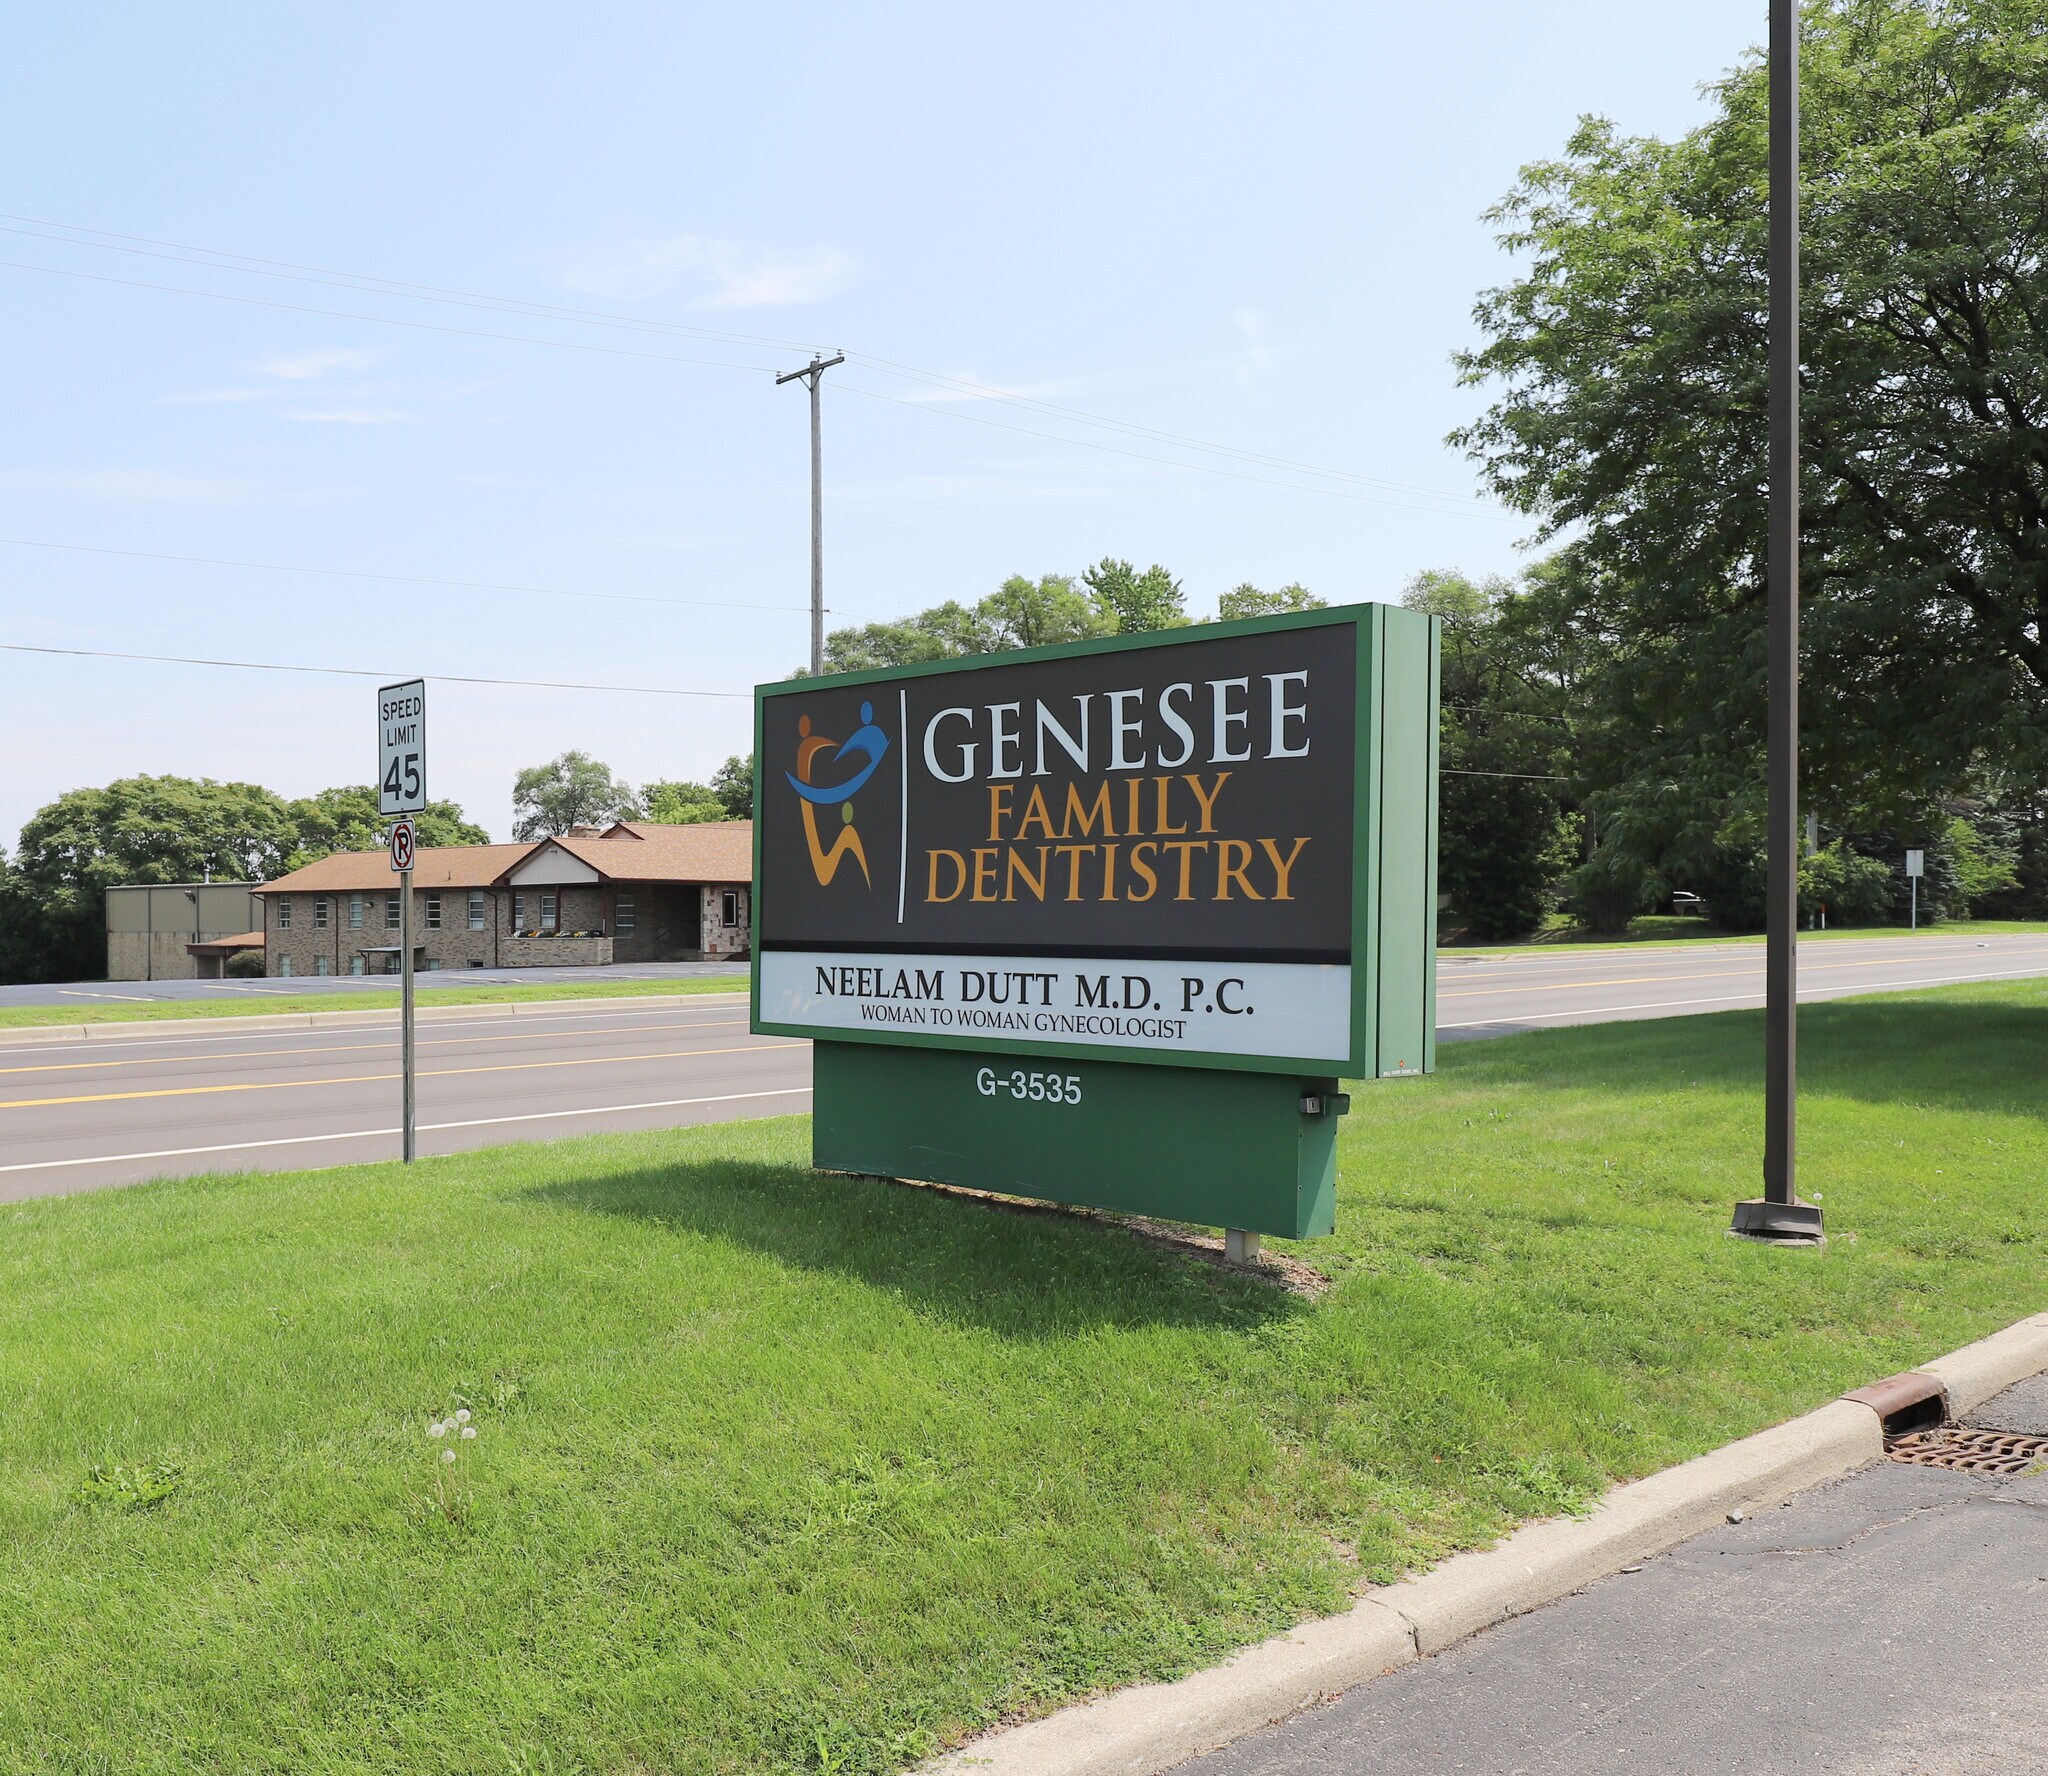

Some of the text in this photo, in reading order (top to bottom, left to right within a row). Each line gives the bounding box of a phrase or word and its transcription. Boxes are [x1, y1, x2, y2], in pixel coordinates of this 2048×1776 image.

[382, 696, 422, 722] SPEED
[922, 669, 1312, 783] GENESEE
[386, 723, 417, 747] LIMIT
[383, 752, 421, 801] 45
[985, 771, 1234, 842] FAMILY
[924, 837, 1312, 903] DENTISTRY
[815, 966, 1255, 1015] NEELAM DUTT M.D. P.C.
[860, 1004, 1187, 1040] WOMAN TO WOMAN GYNECOLOGIST
[975, 1067, 1083, 1105] G-3535
